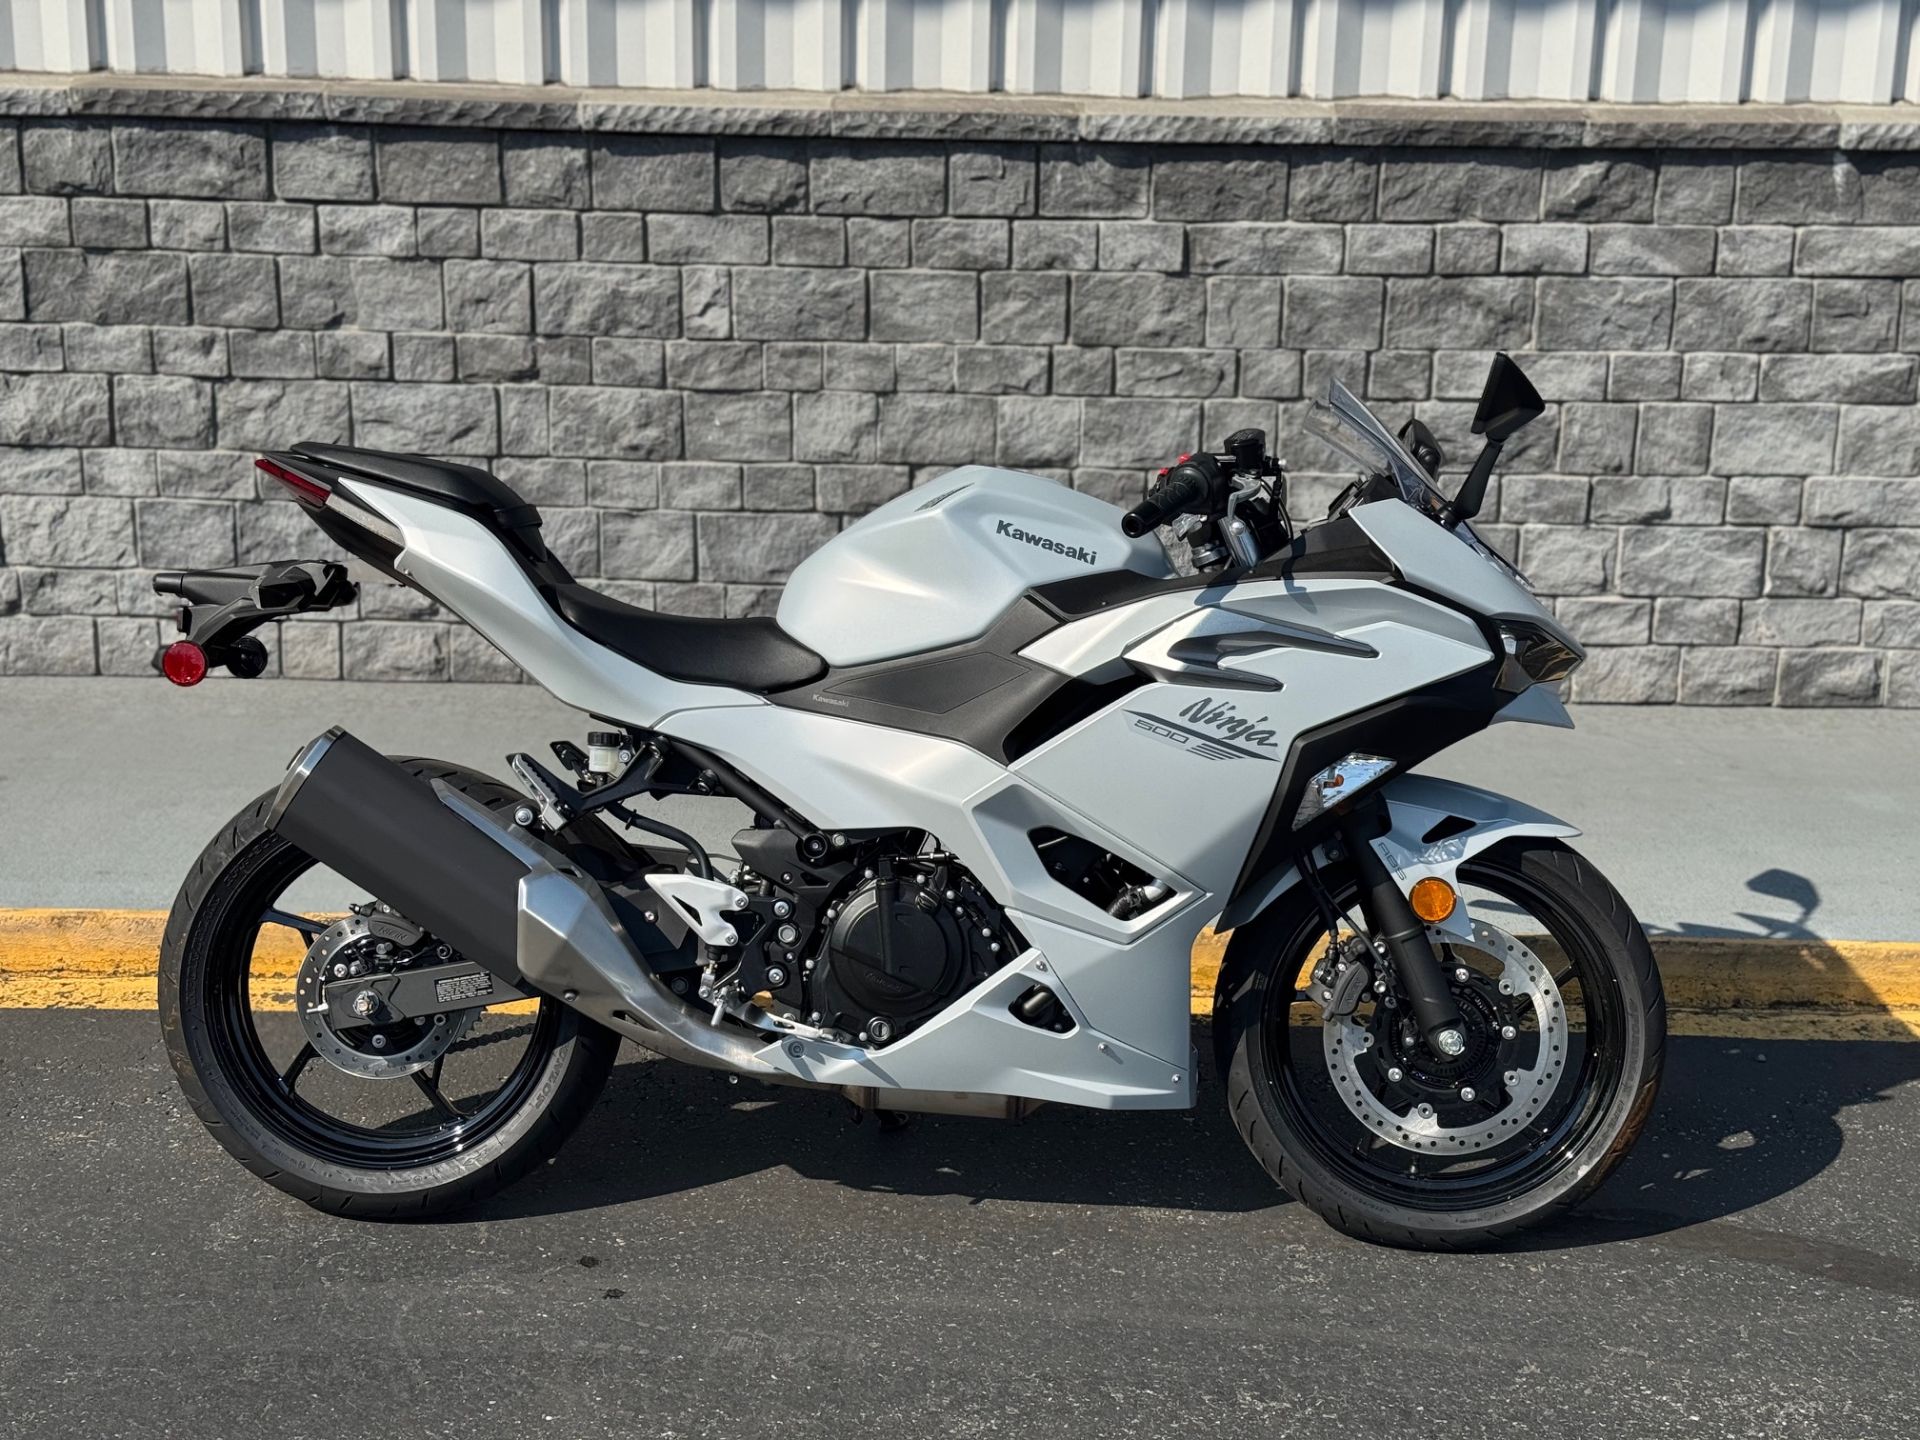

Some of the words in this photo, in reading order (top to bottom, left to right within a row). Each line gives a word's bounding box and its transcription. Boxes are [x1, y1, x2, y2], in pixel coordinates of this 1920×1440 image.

[996, 519, 1097, 565] Kawasaki
[812, 694, 849, 707] Kawasaki
[1134, 719, 1189, 744] 500
[1179, 697, 1278, 747] Ninja
[1378, 842, 1407, 880] ABS
